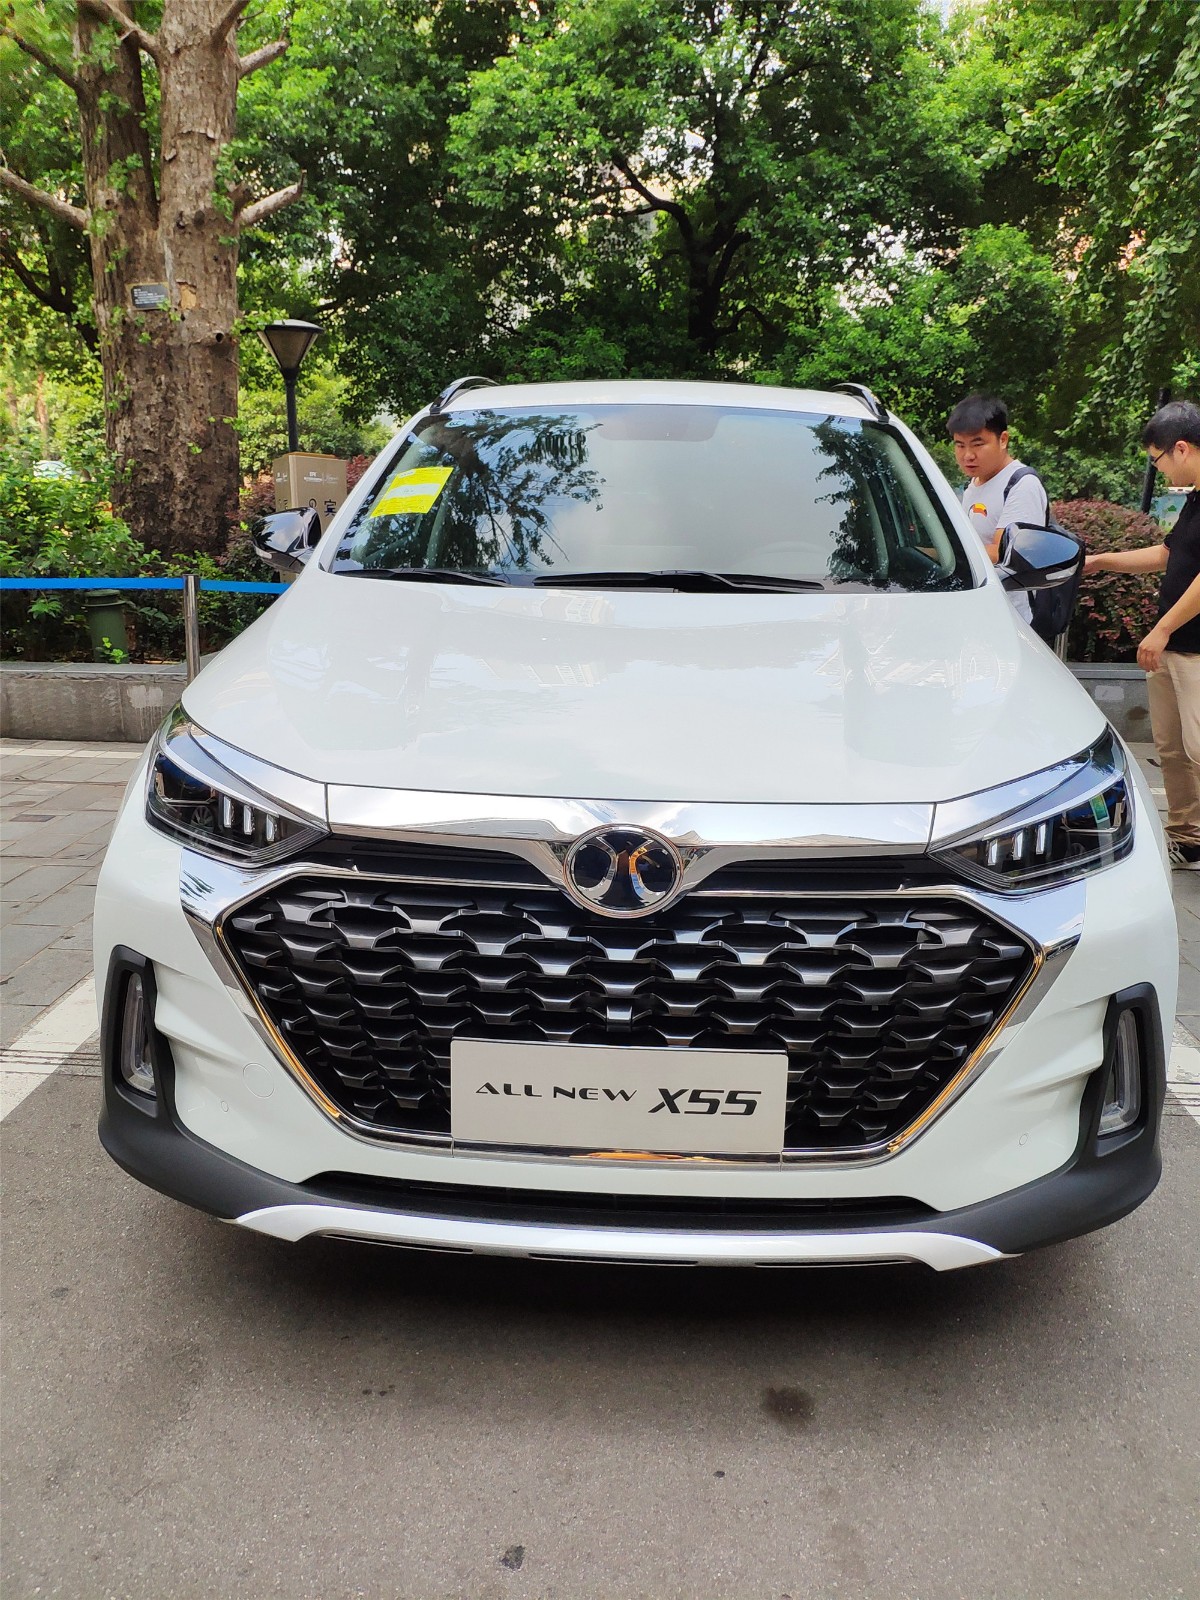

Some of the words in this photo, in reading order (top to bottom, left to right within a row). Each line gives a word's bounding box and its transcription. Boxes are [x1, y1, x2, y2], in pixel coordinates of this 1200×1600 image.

[475, 1082, 542, 1098] ALL
[553, 1086, 637, 1102] NEW
[647, 1087, 762, 1116] X55
